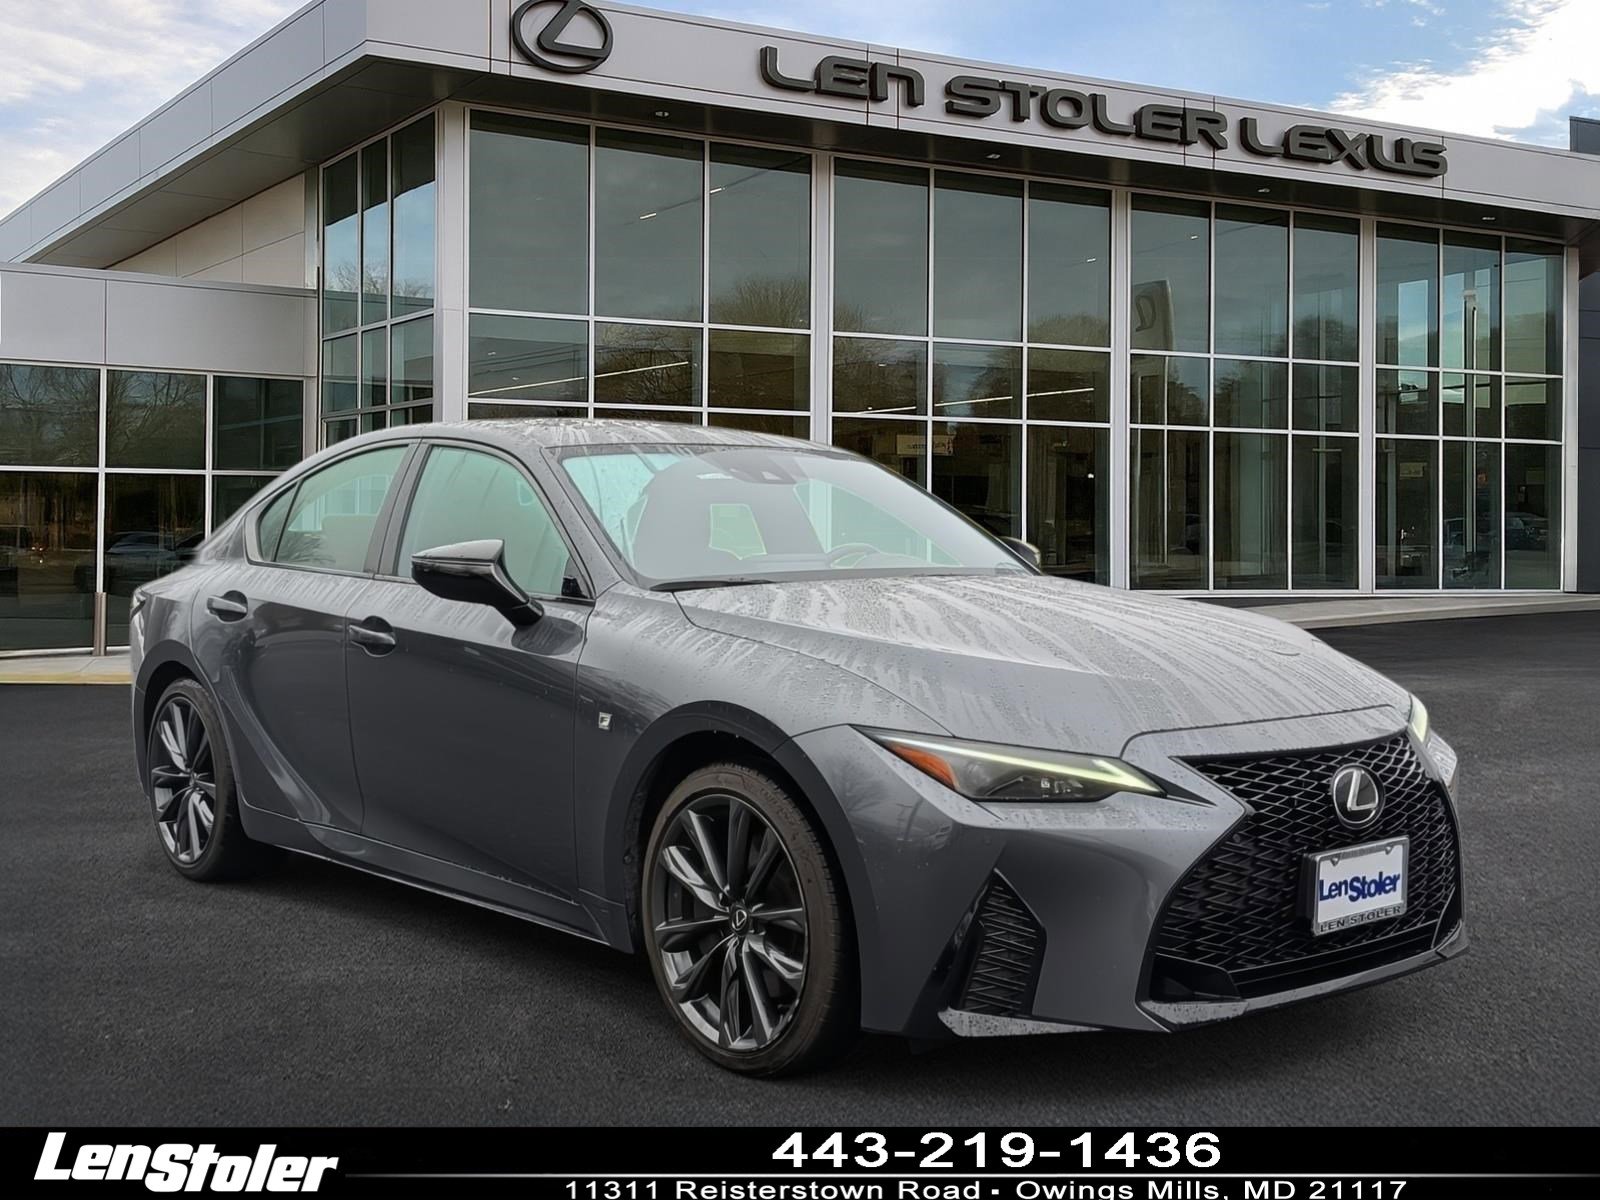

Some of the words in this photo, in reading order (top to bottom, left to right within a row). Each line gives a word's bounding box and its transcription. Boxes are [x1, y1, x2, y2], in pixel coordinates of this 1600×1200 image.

[945, 75, 1229, 150] STOLER
[1239, 117, 1448, 177] LEXUS
[1319, 871, 1400, 902] LenStoler
[1320, 919, 1346, 933] LEN
[1350, 906, 1401, 924] STOLER
